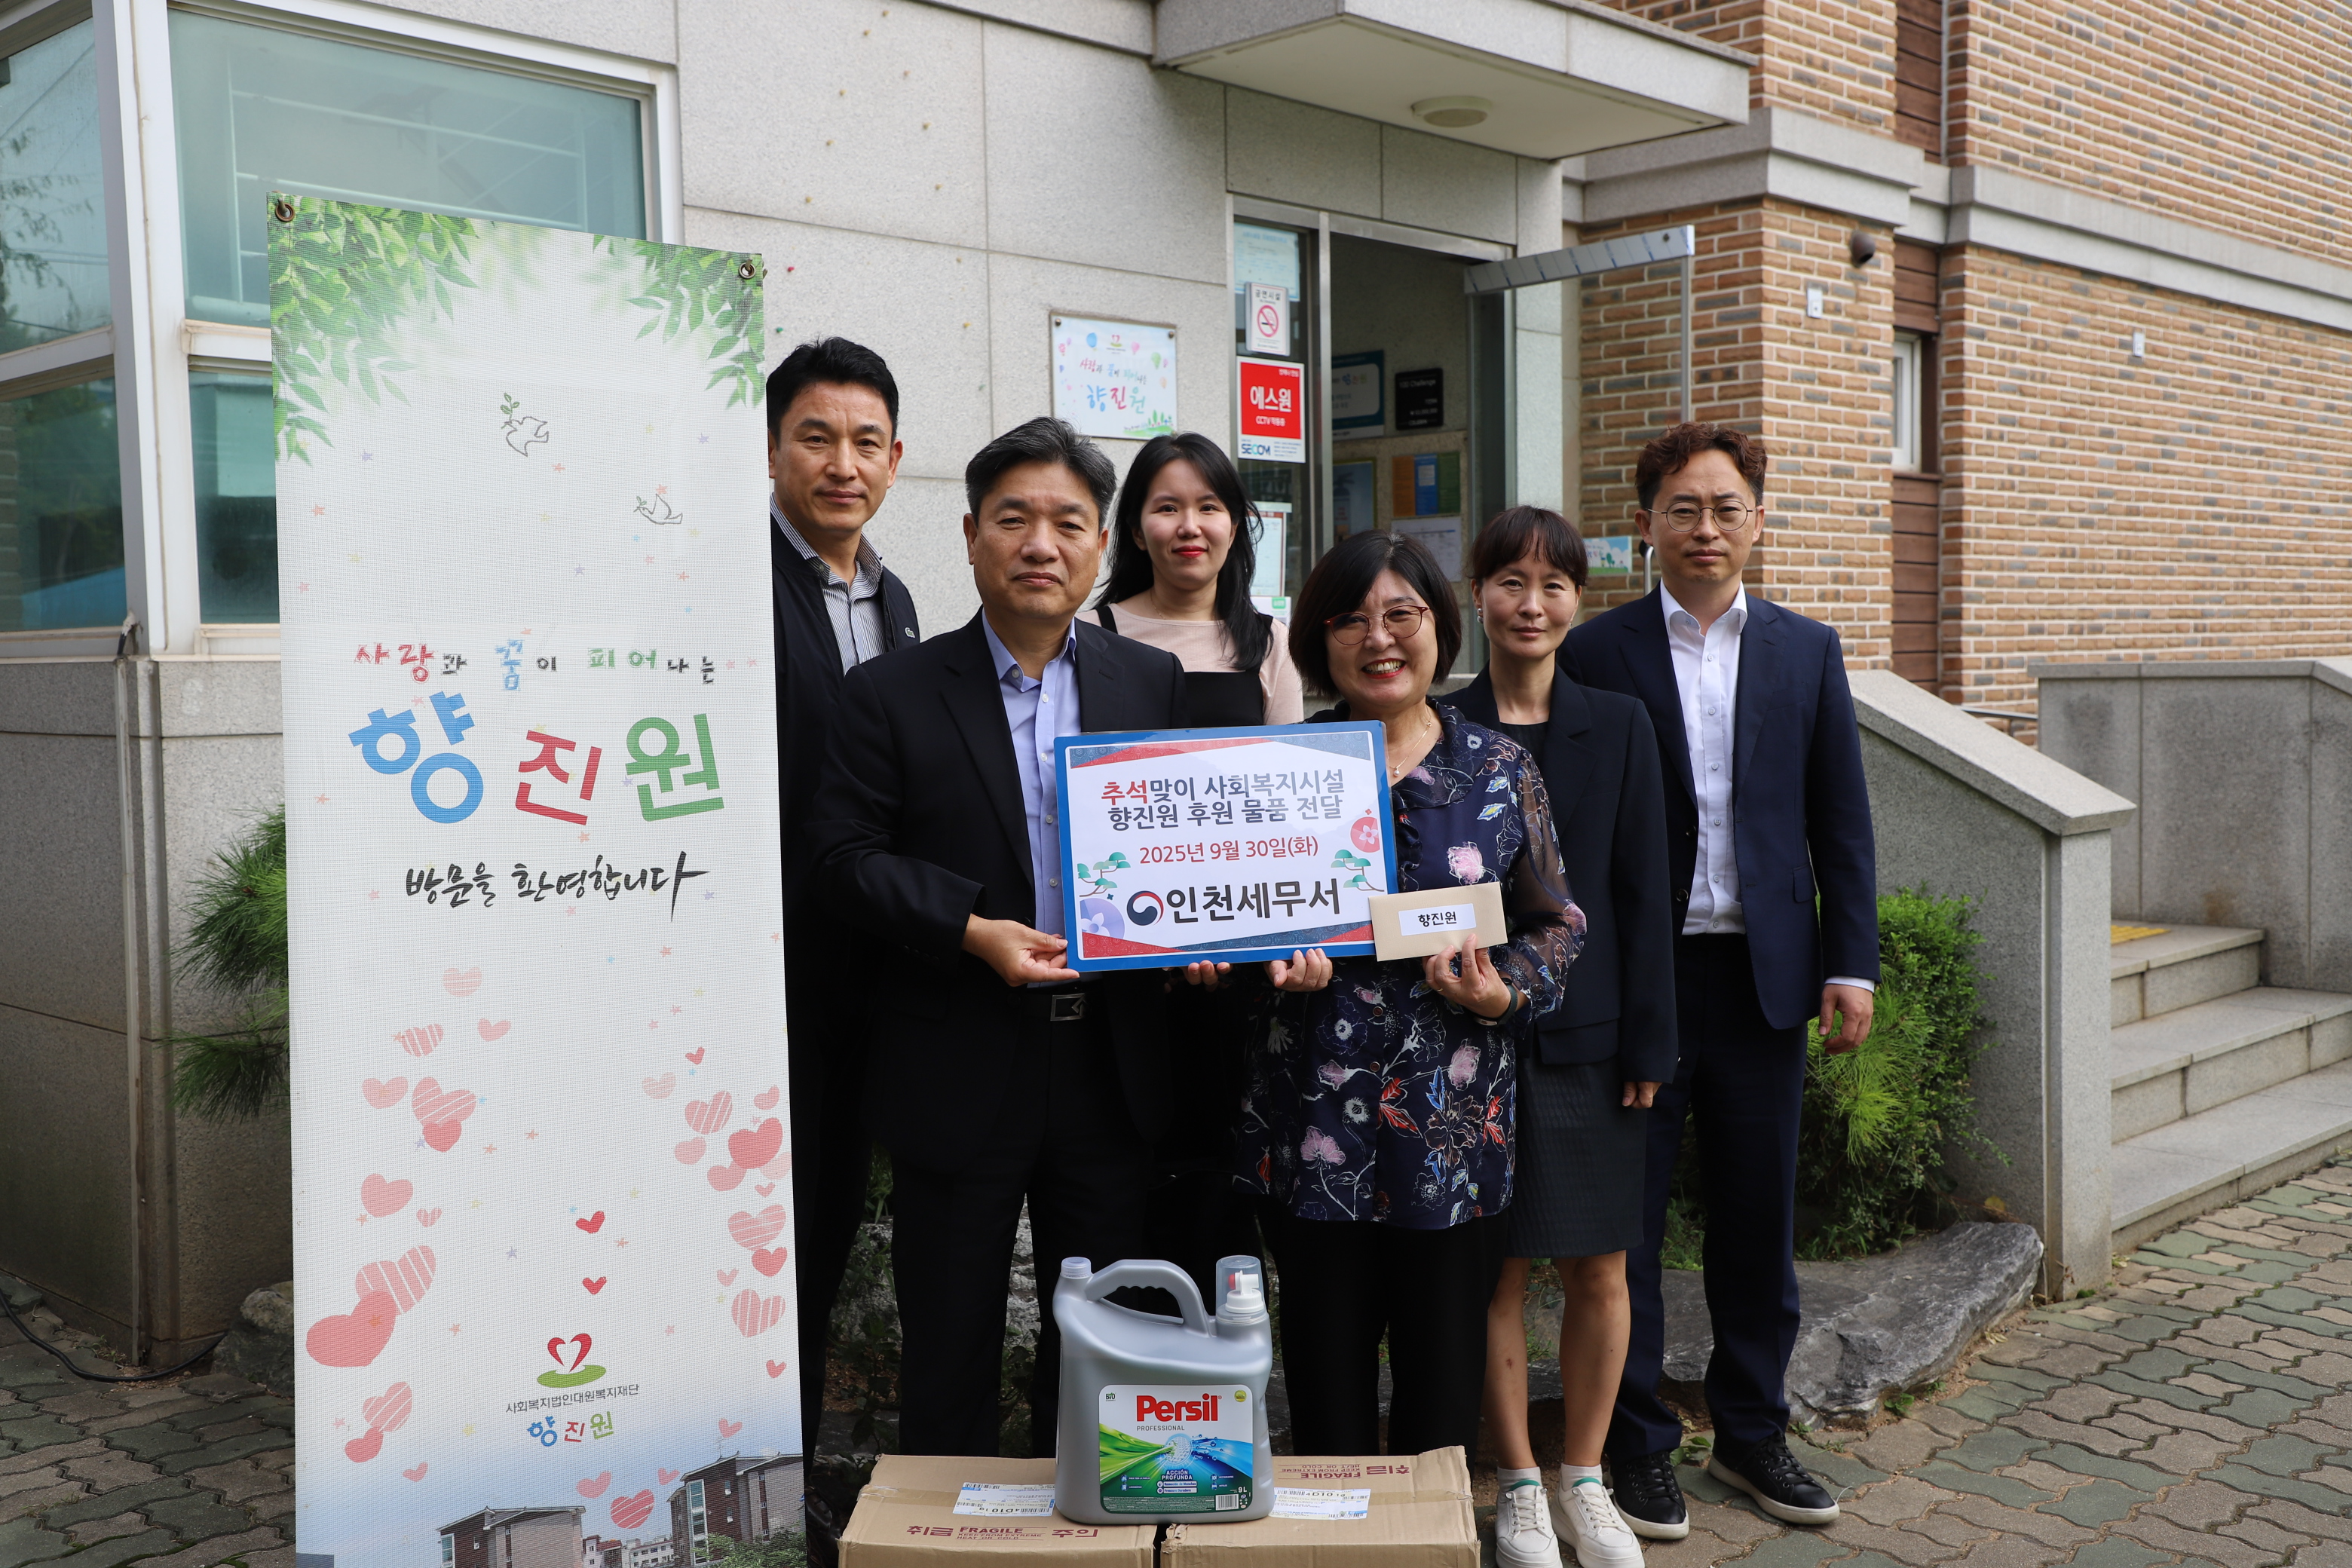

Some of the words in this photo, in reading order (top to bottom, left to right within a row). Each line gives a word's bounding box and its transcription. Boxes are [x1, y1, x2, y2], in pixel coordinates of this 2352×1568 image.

[1086, 384, 1146, 415] 향진원
[1250, 385, 1291, 412] 에스원
[1241, 443, 1271, 455] SECOM
[354, 642, 467, 682] 사랑과
[495, 639, 557, 691] 꿈이
[587, 648, 715, 684] 피어나는
[348, 691, 724, 825] 향진원
[1101, 776, 1196, 807] 추석맞이
[1204, 767, 1345, 801] 사회복지시설
[1109, 802, 1179, 831] 향진원
[1187, 799, 1235, 827] 후원
[1241, 797, 1288, 824] 물품
[1297, 794, 1343, 821] 전달
[1139, 842, 1205, 865] 2025년
[1210, 838, 1240, 861] 9월
[1246, 835, 1319, 859] 30일(화)
[405, 862, 495, 909] 방문을
[511, 850, 711, 923] 환영합니다
[1166, 877, 1341, 924] 인천세무서
[1417, 911, 1458, 929] 향진원
[505, 1383, 640, 1414] 사회복지법인대원복지재단
[1136, 1393, 1218, 1422] Persil
[526, 1410, 614, 1447] 향진원
[1366, 1465, 1410, 1475] 취급
[907, 1525, 954, 1537] 취급
[1052, 1529, 1098, 1538] 주의
